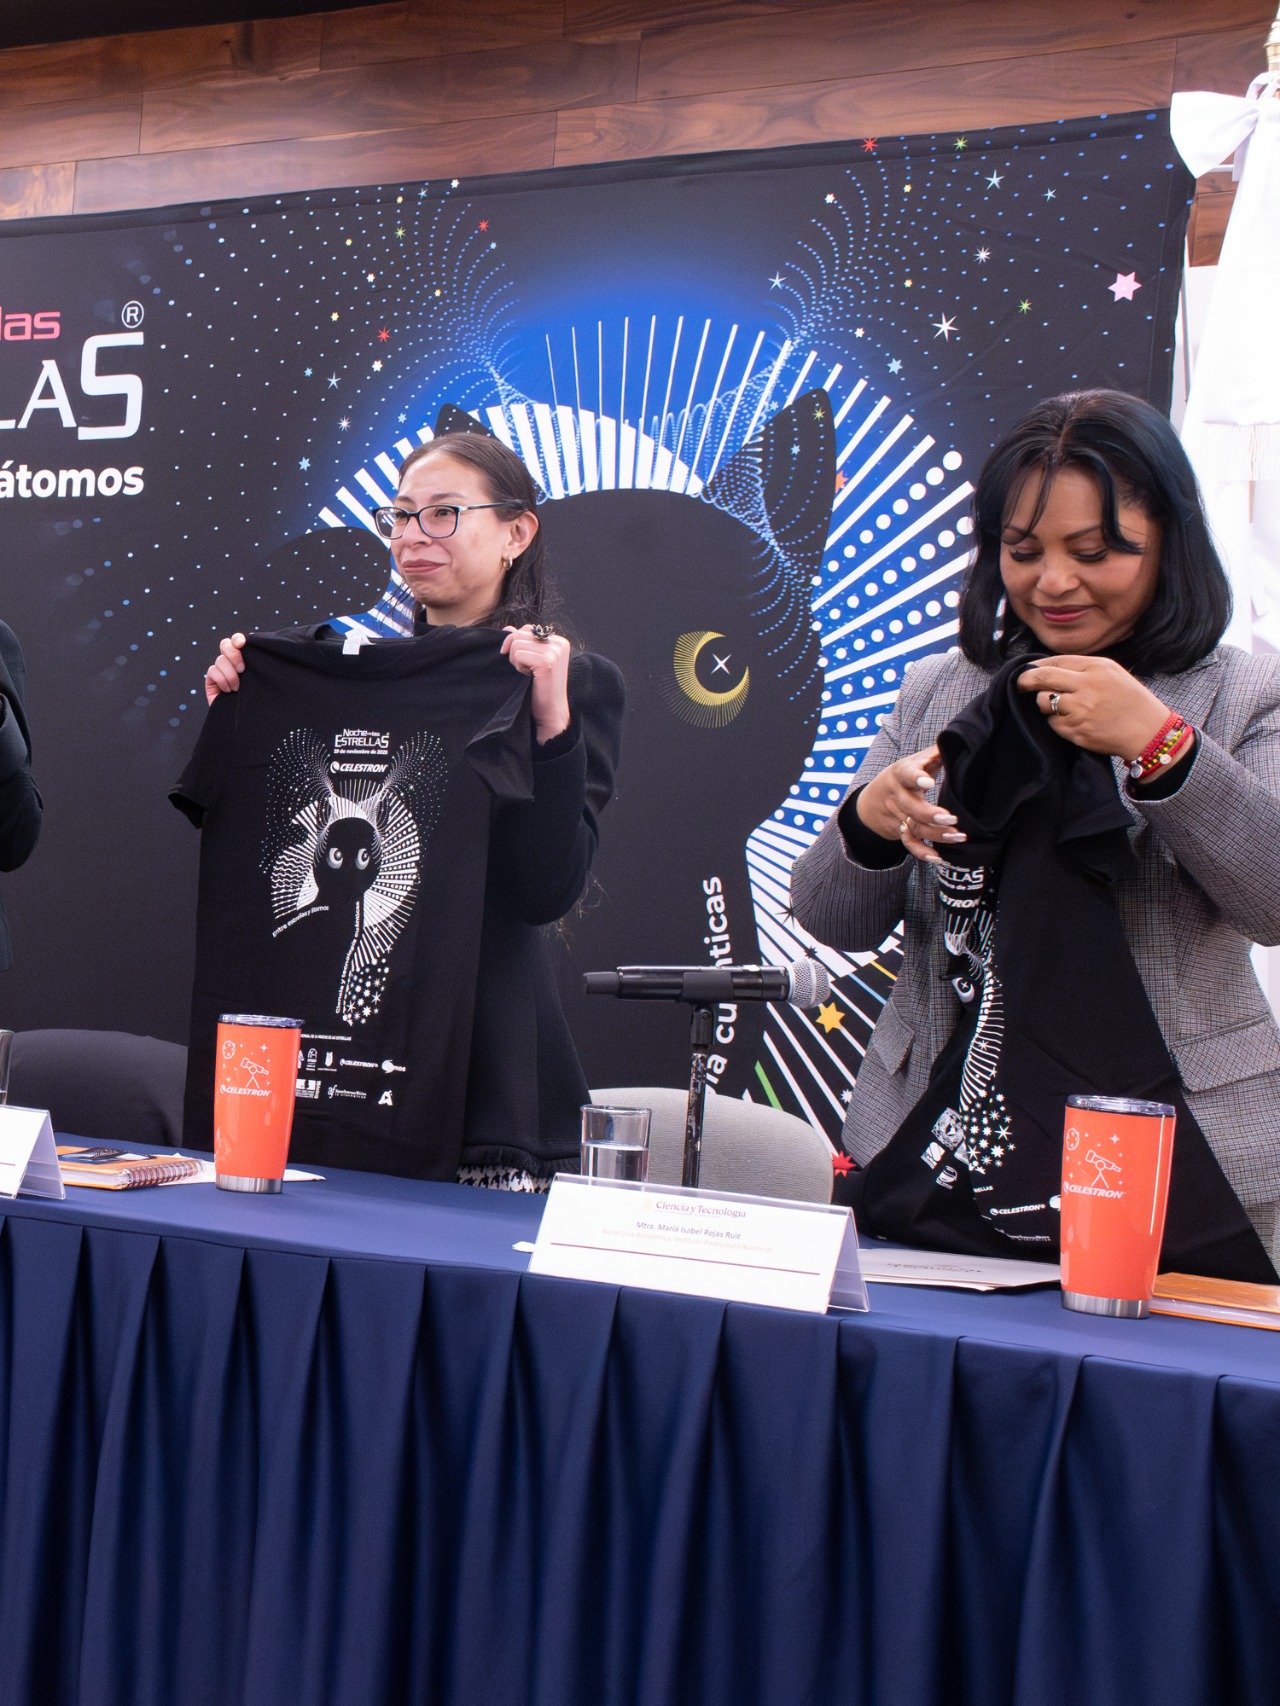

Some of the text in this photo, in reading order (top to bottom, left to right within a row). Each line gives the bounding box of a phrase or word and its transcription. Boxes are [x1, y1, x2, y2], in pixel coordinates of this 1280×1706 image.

[342, 728, 368, 737] Noche
[335, 735, 389, 748] ESTRELLAS
[340, 763, 388, 772] CELESTRON
[225, 1087, 271, 1097] CELESTRON
[1069, 1184, 1123, 1199] CELESTRON
[655, 1200, 690, 1213] Ciencia
[697, 1204, 747, 1218] Tecnología
[998, 1204, 1041, 1215] CELESTRON
[636, 1221, 741, 1240] Mtra. María Isabel Rojas Ruiz
